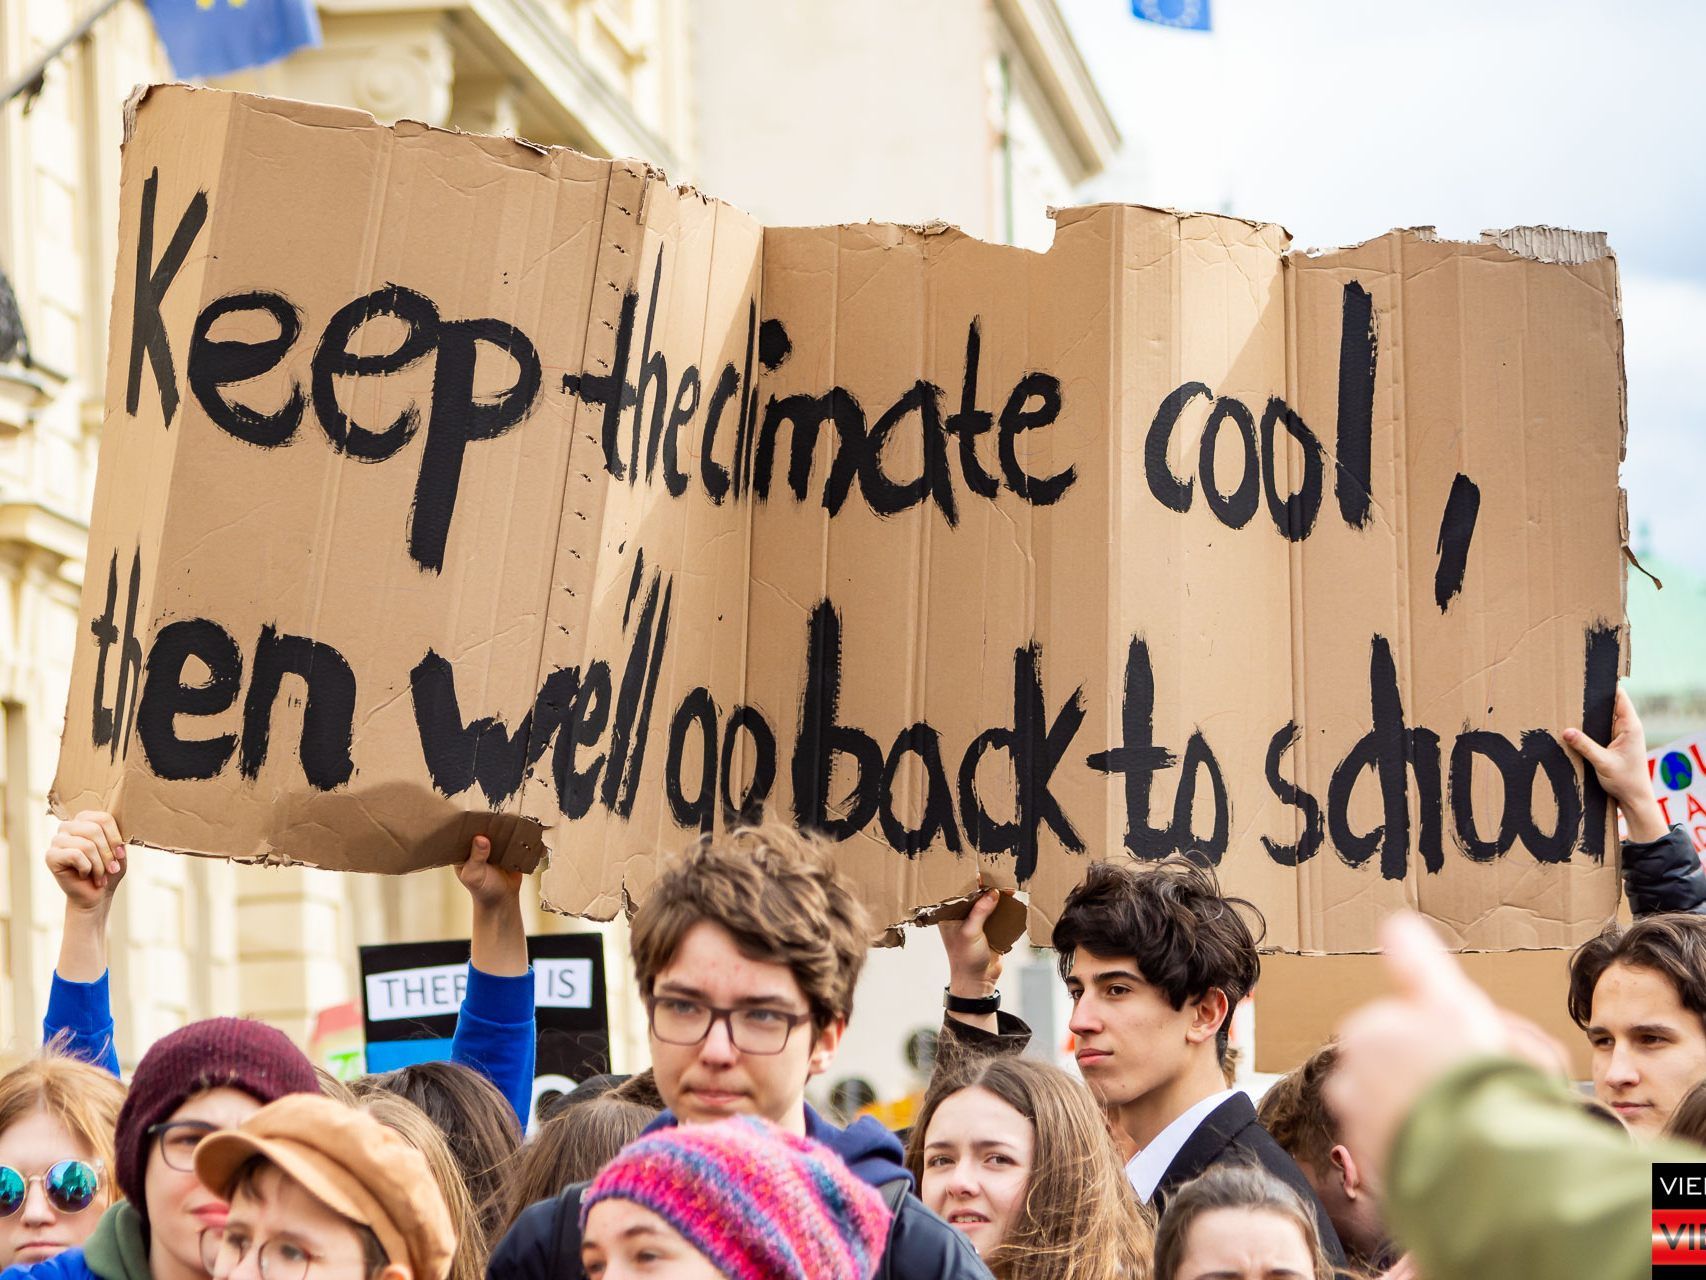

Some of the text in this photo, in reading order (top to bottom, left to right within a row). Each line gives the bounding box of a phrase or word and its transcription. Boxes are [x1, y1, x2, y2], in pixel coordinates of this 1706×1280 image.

[127, 166, 542, 575] Keep
[562, 241, 700, 500] the
[699, 295, 1077, 529] climate
[91, 542, 357, 792] then
[665, 686, 777, 845] go
[792, 597, 1086, 883] back
[1087, 633, 1230, 868] to
[1258, 619, 1623, 881] school
[548, 968, 575, 999] IS
